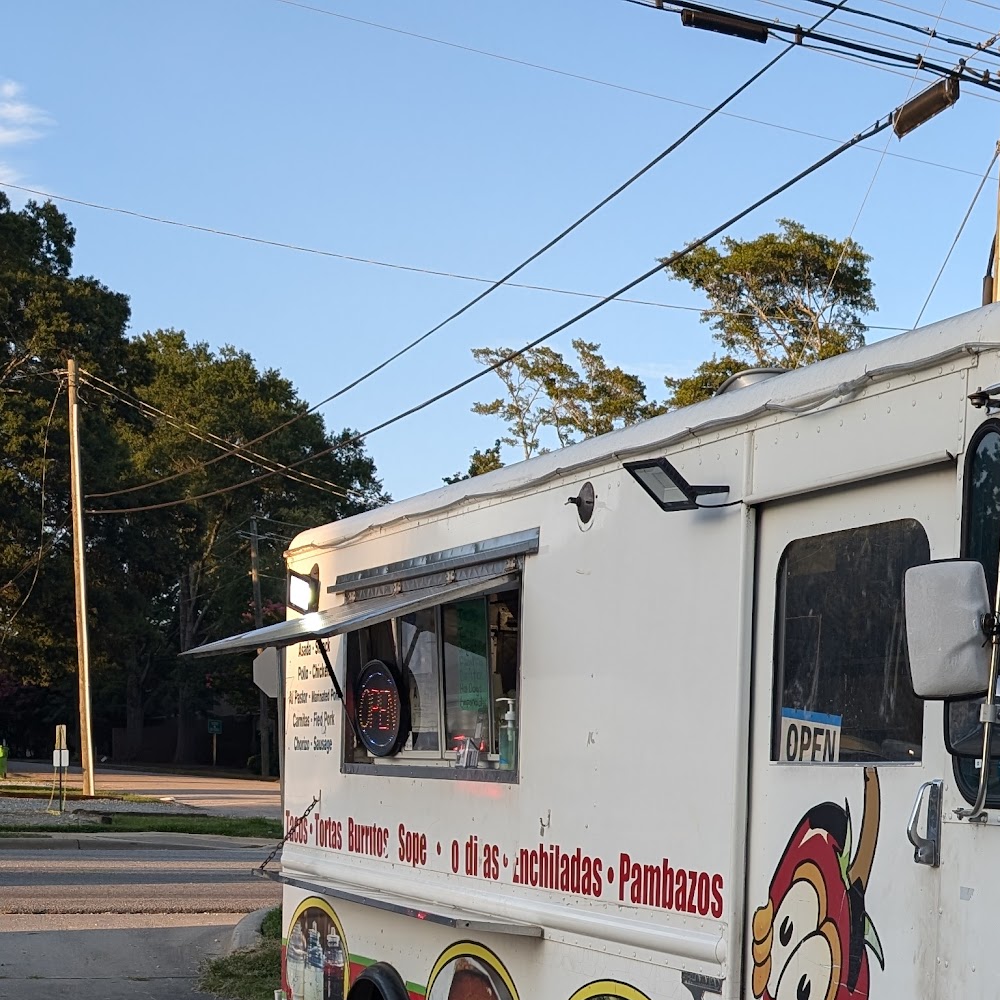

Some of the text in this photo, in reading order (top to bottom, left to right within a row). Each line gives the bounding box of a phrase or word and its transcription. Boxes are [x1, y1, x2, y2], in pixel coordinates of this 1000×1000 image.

[298, 663, 330, 680] Pollo Chicke
[295, 689, 308, 704] Pastor
[359, 688, 397, 731] OPEN
[292, 712, 310, 727] Carnitas
[324, 710, 335, 727] Pork
[786, 723, 837, 762] OPEN
[285, 809, 308, 845] Tacos
[314, 812, 343, 851] Tortas
[618, 852, 724, 919] Pambazos
